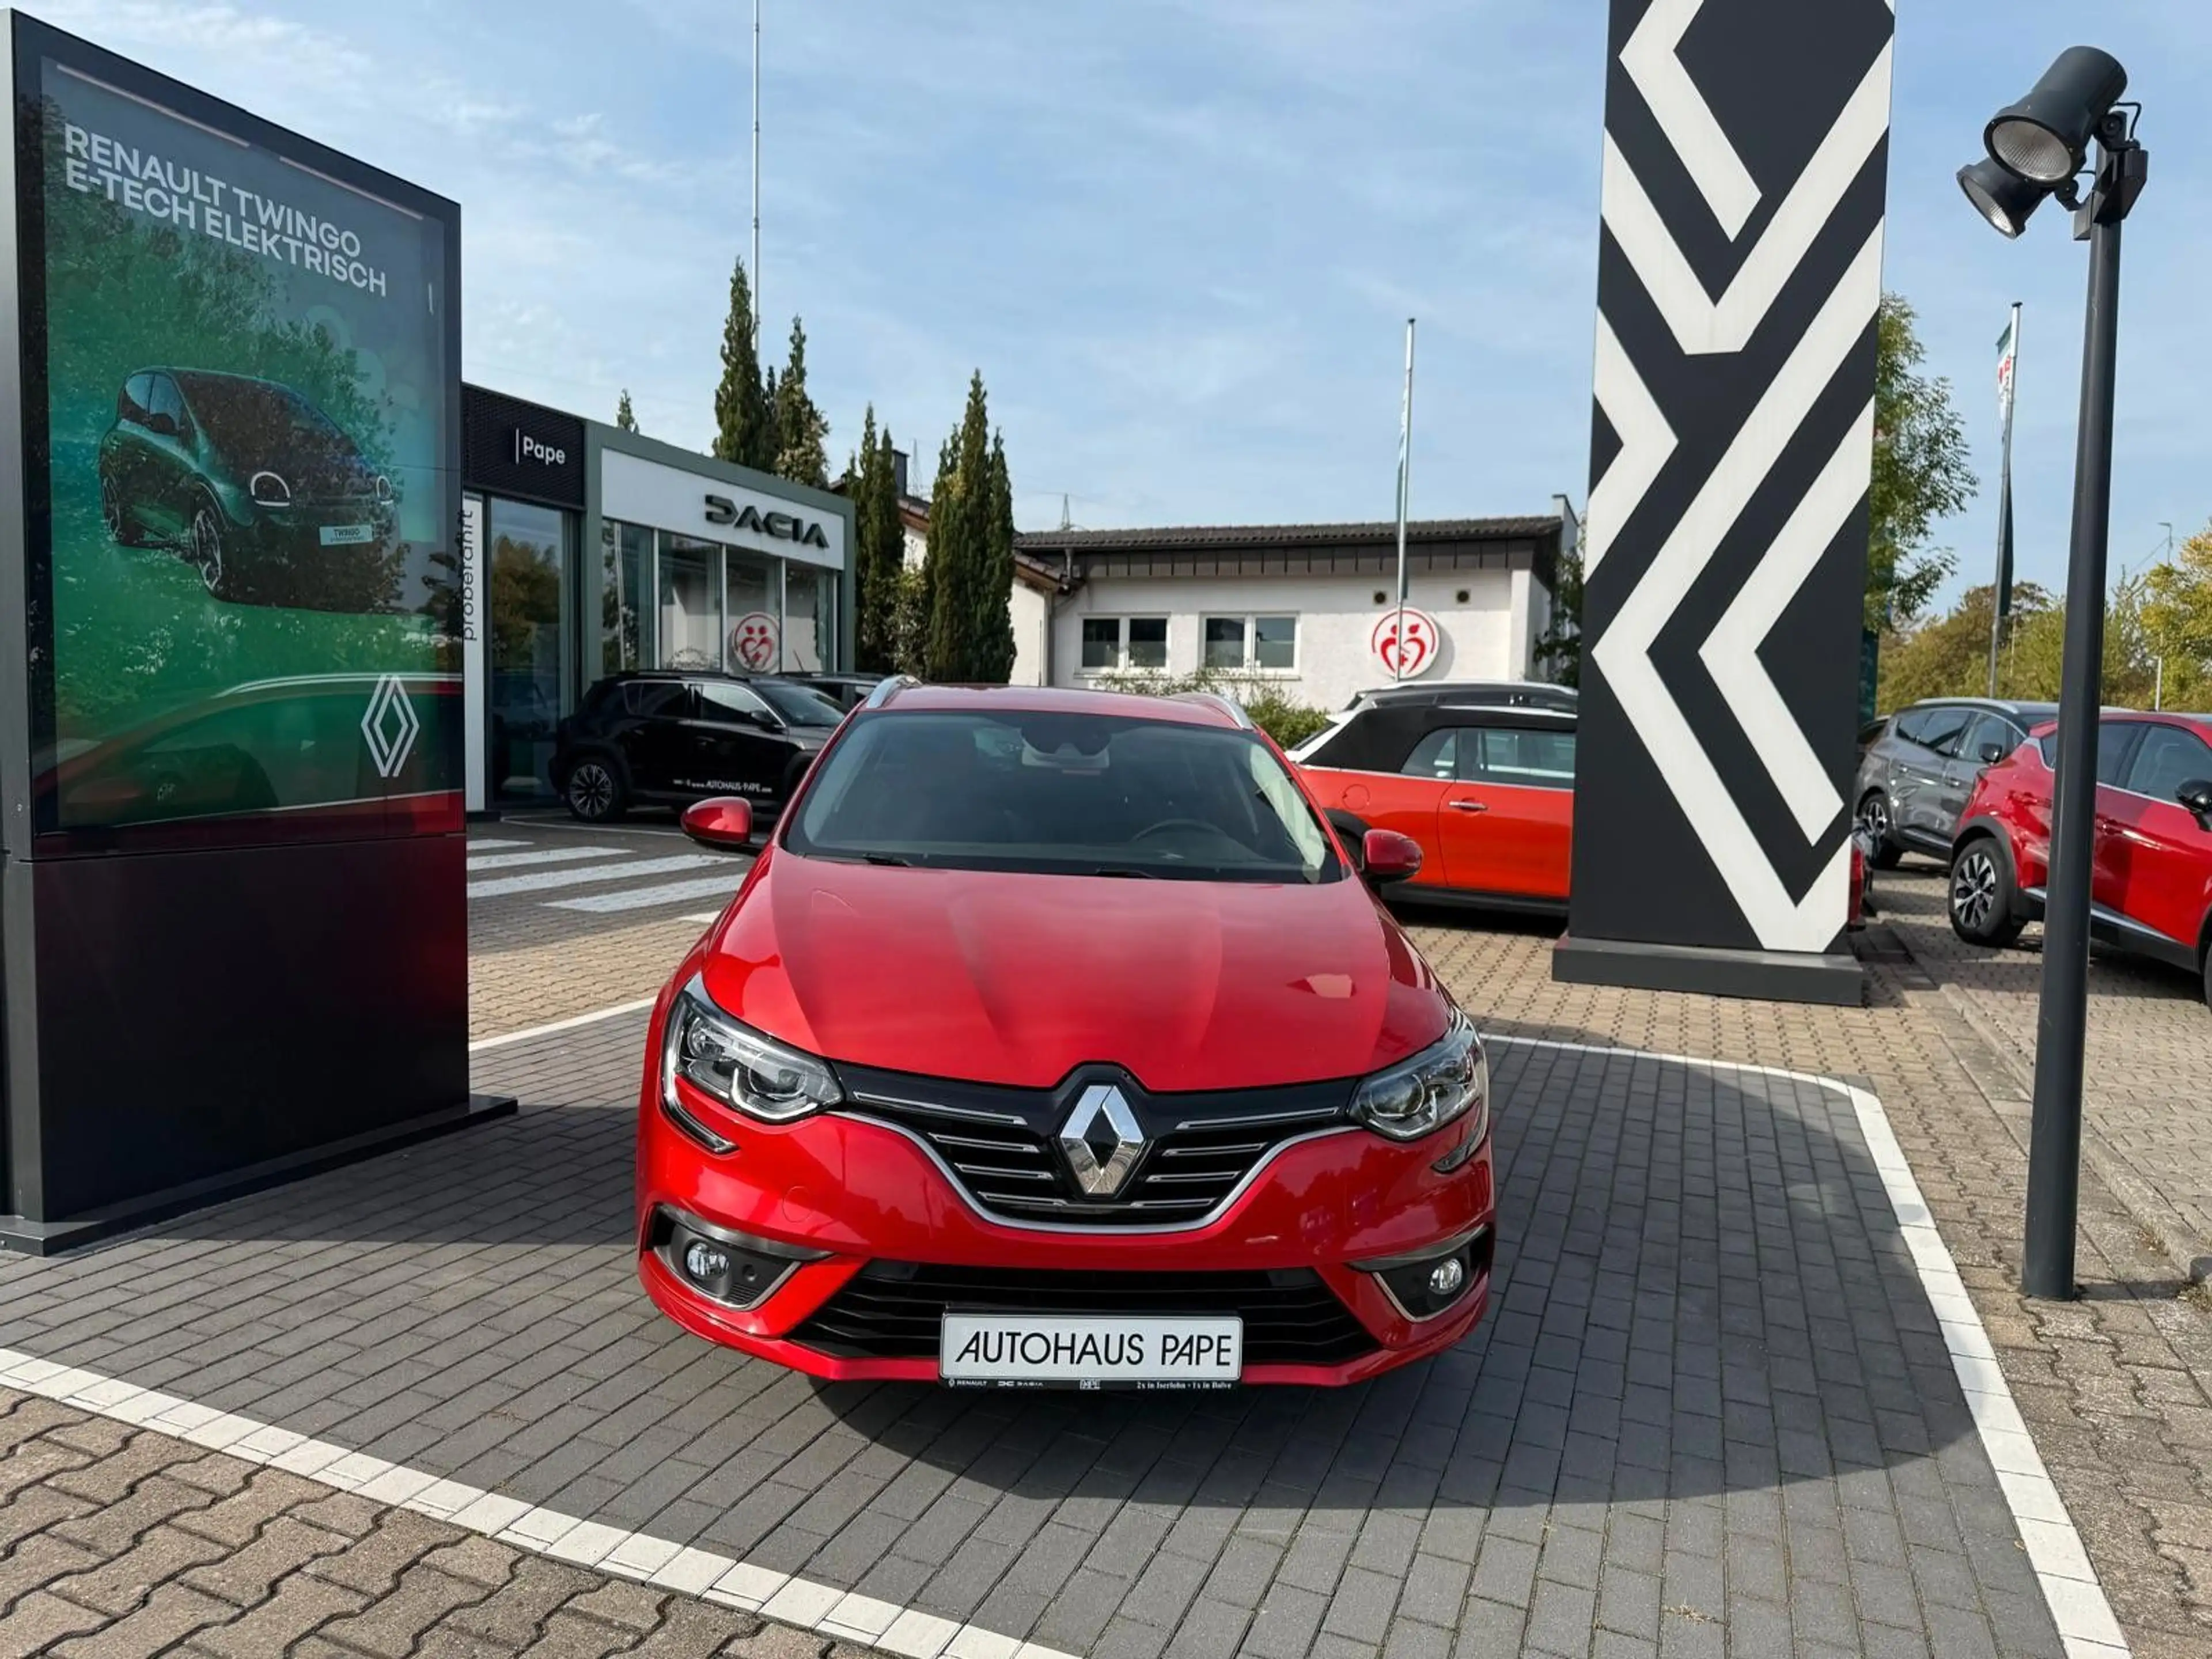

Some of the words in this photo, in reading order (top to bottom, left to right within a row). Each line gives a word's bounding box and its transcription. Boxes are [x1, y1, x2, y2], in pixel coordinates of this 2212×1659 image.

[65, 123, 226, 206] RENAULT
[232, 185, 361, 258] TWINGO
[66, 157, 195, 230] E-TECH
[204, 207, 387, 297] ELEKTRISCH
[523, 435, 565, 465] Pape
[704, 494, 830, 548] DACIA
[956, 1331, 1145, 1366] AUTOHAUS
[1161, 1334, 1232, 1366] PAPE
[1147, 1381, 1155, 1389] in
